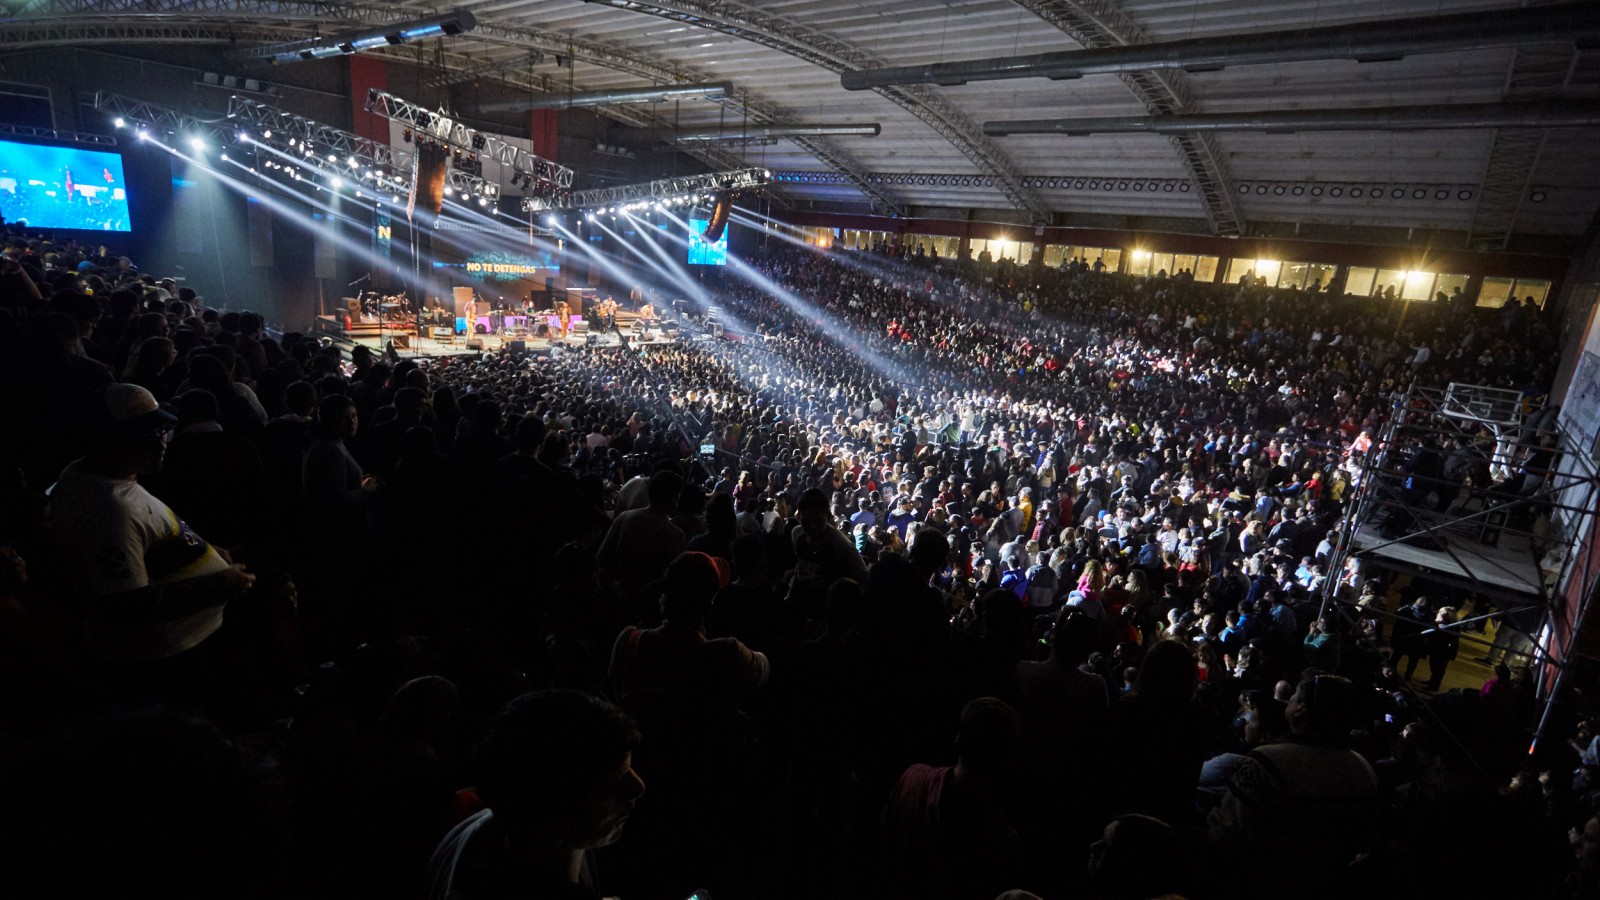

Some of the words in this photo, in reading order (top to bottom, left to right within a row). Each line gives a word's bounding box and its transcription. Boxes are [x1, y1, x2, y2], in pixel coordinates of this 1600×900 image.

[378, 225, 391, 240] N
[466, 262, 481, 272] NO
[482, 263, 493, 272] TE
[494, 264, 535, 274] DETENGAS
